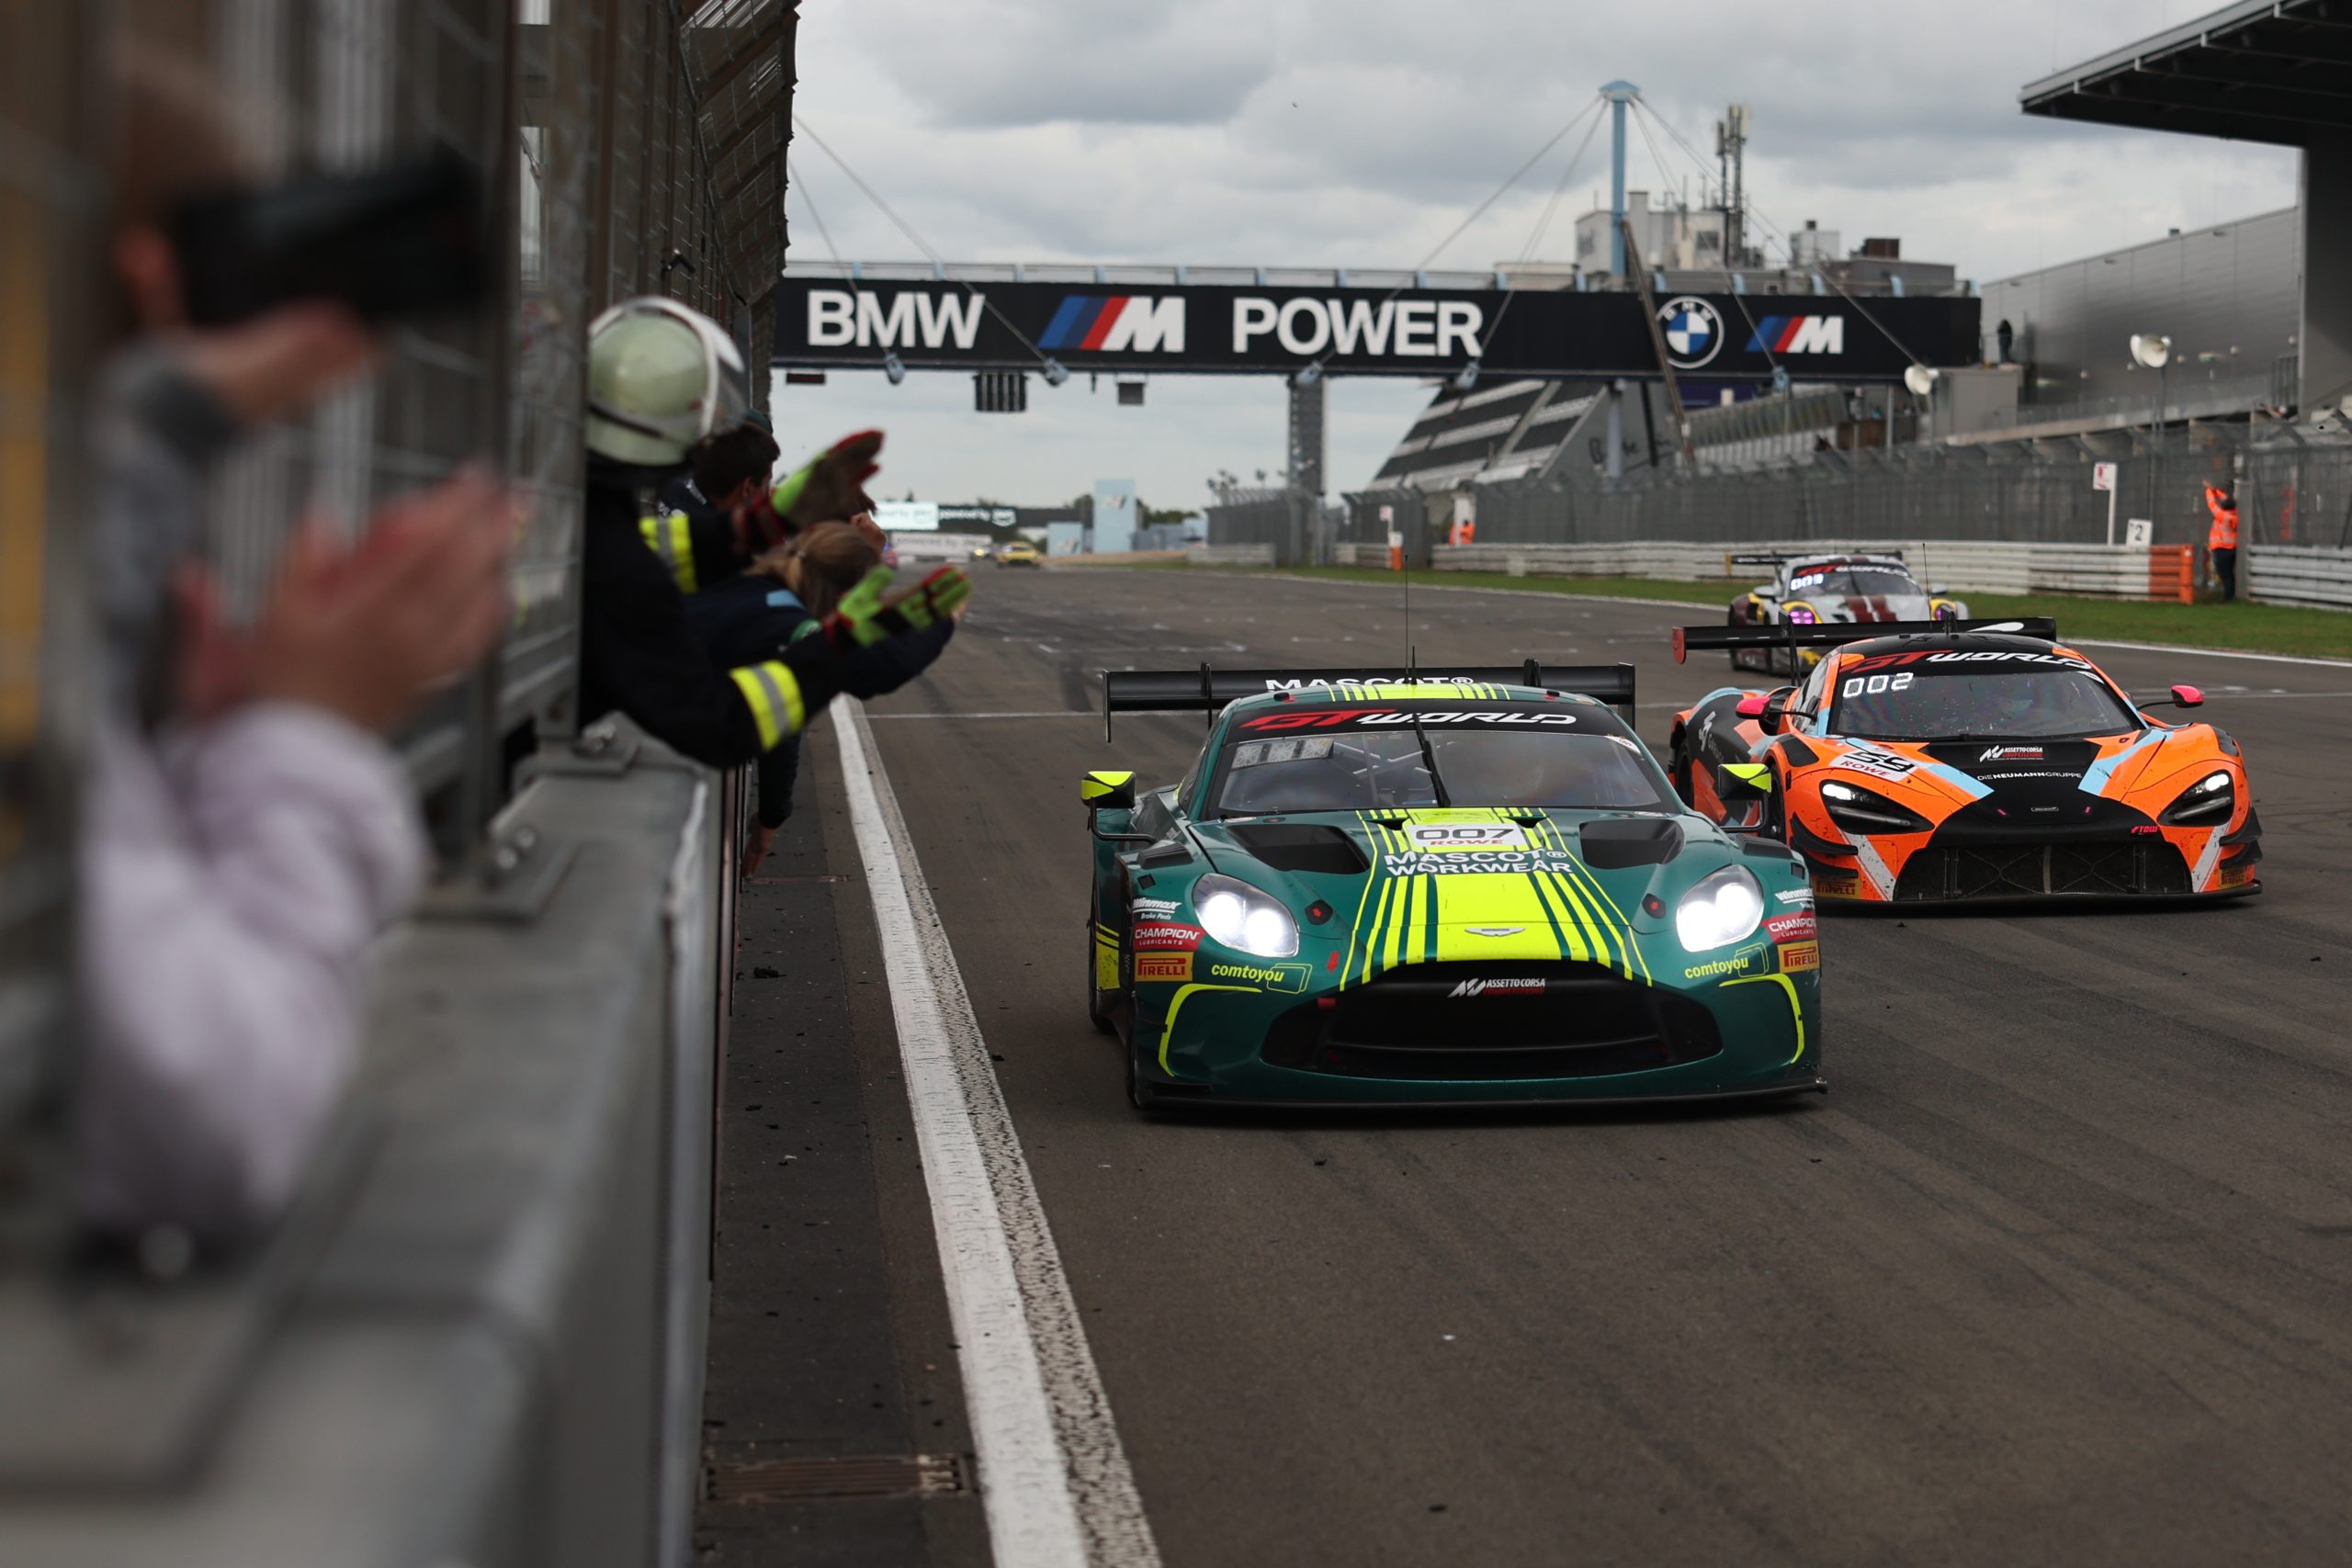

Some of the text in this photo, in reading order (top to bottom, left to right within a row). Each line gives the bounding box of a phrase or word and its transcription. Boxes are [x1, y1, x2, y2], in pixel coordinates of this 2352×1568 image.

[808, 290, 985, 349] BMW
[1102, 296, 1185, 353] M
[1232, 298, 1483, 357] POWER
[1786, 315, 1844, 355] M
[1842, 671, 1914, 698] 002
[1840, 761, 1892, 777] ROWE
[1415, 829, 1514, 840] 007
[1386, 862, 1573, 876] WORKWEAR
[1135, 928, 1198, 941] CHAMPION
[1783, 946, 1818, 967] PIRELLI
[1137, 958, 1186, 976] PIRELLI
[1211, 964, 1284, 983] comtoyou
[1684, 957, 1749, 979] comtoyou
[1487, 978, 1546, 988] ASSETTO CORSA
